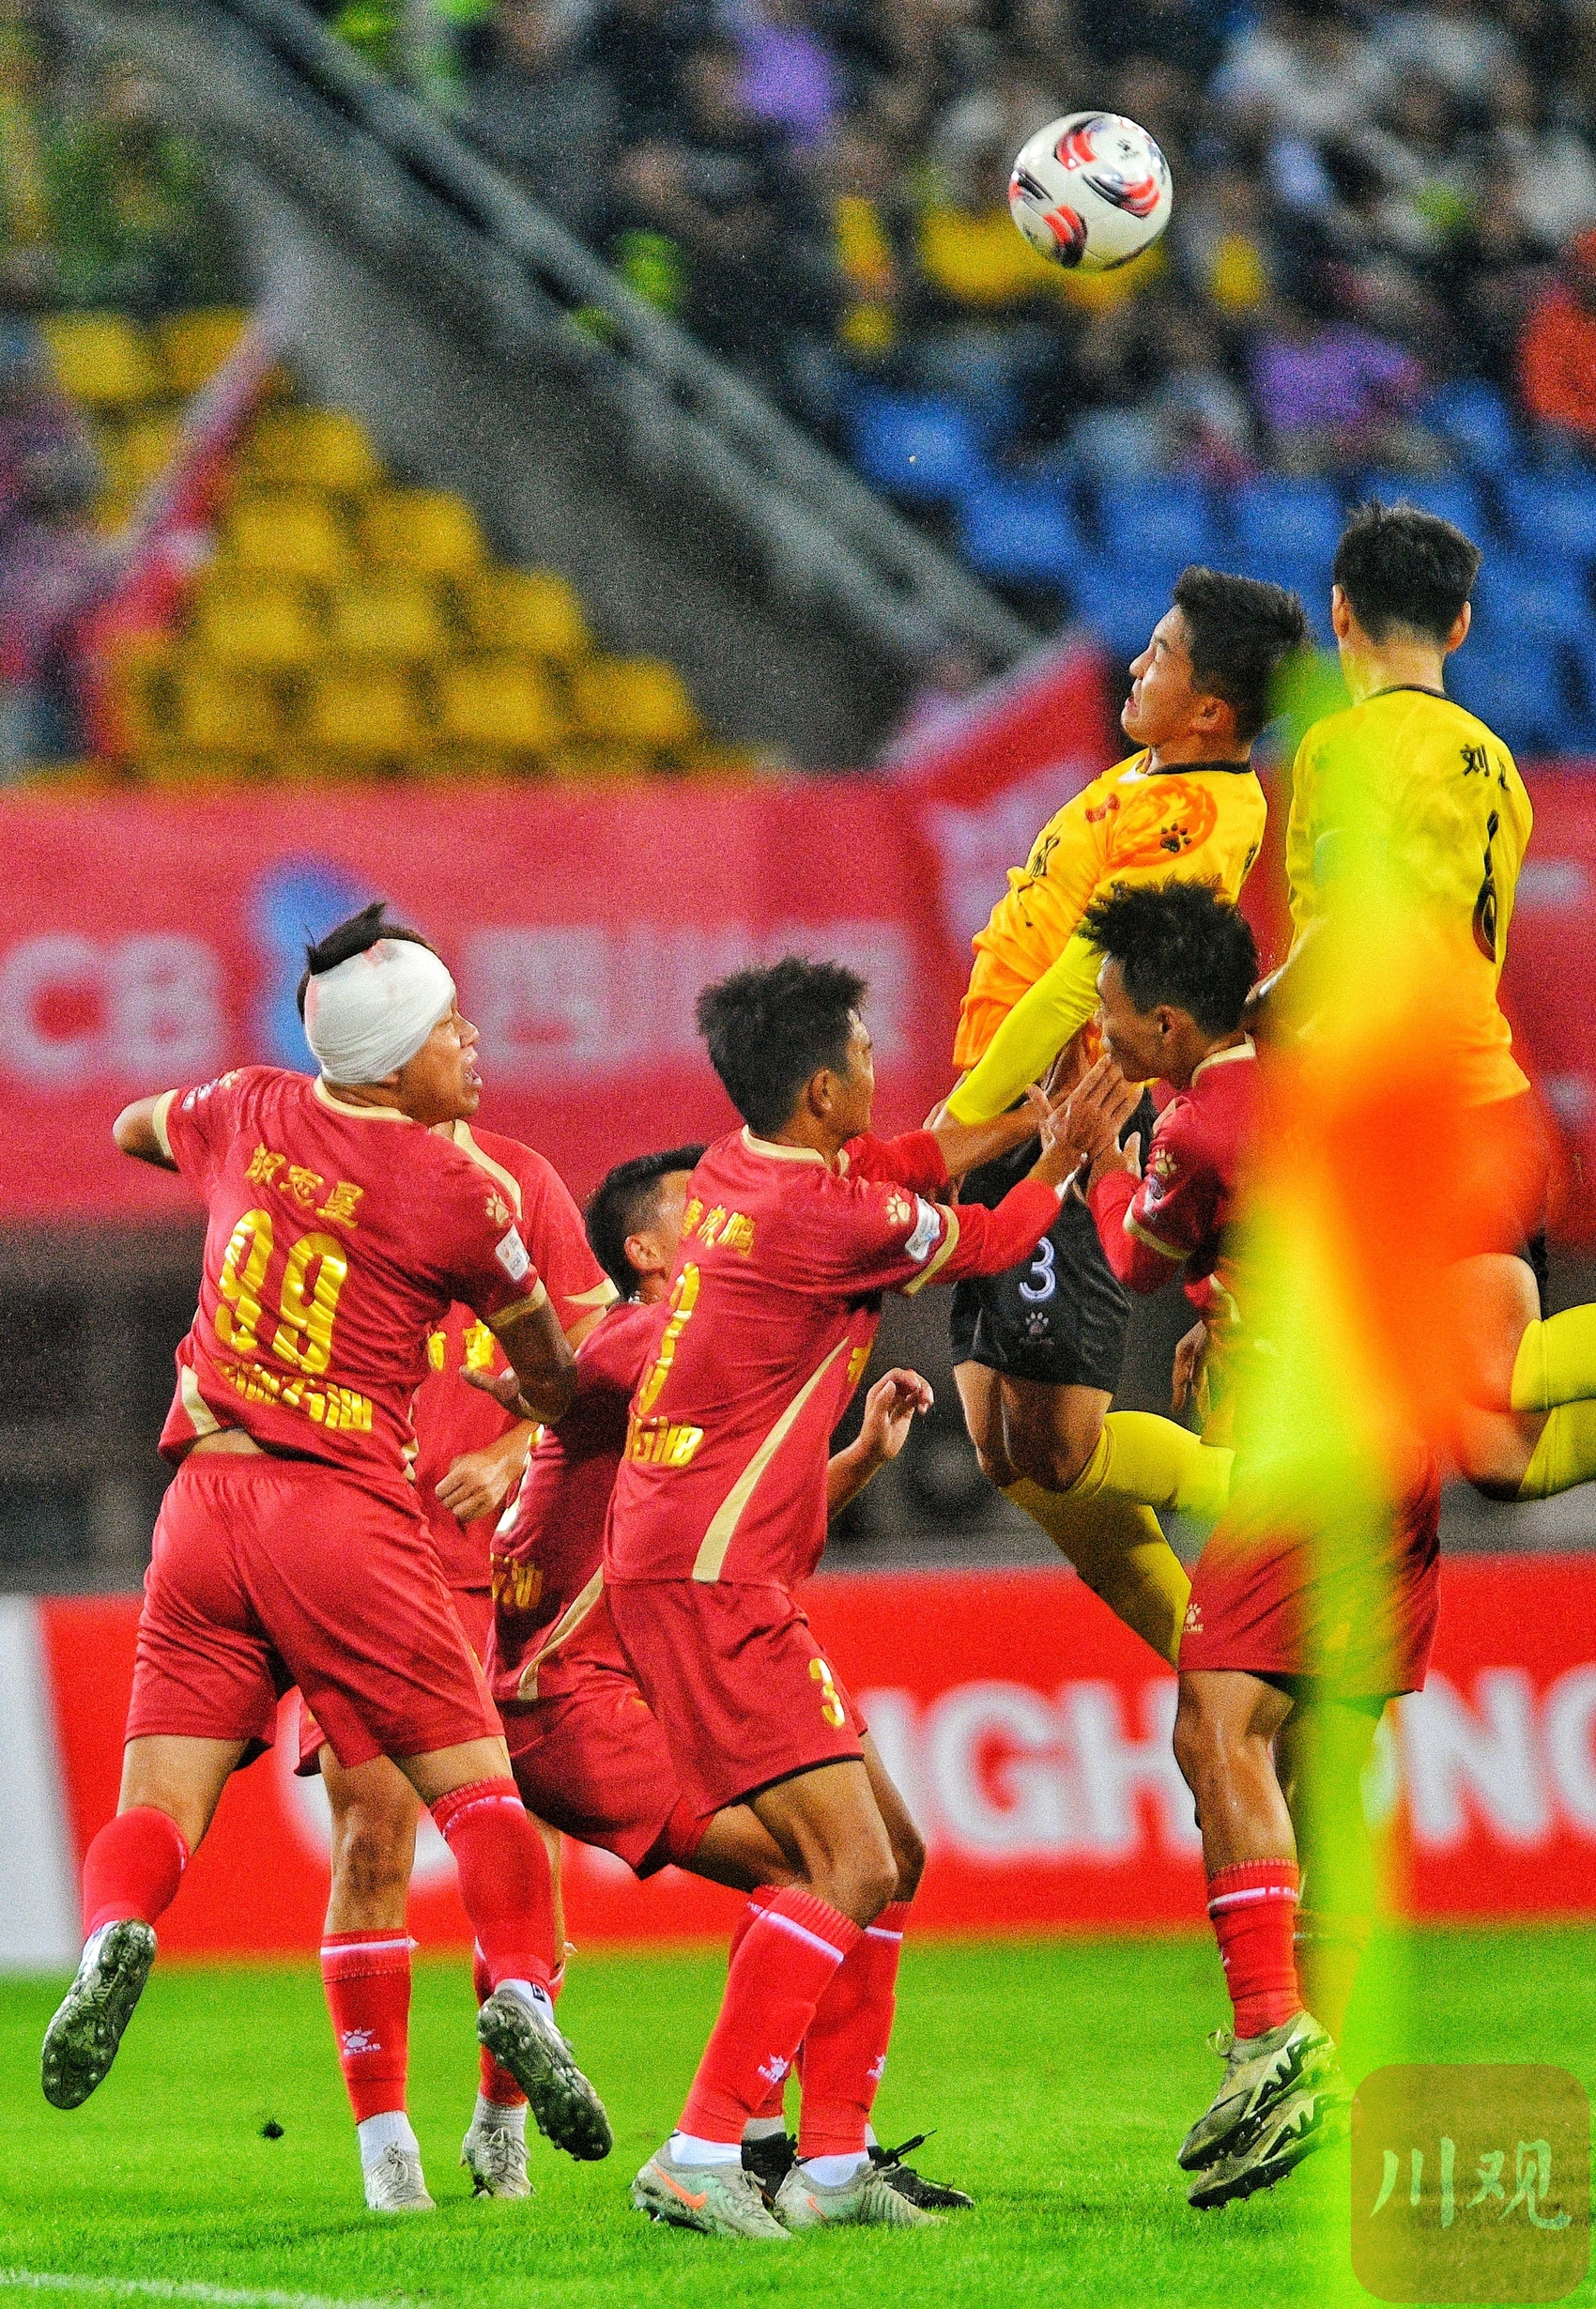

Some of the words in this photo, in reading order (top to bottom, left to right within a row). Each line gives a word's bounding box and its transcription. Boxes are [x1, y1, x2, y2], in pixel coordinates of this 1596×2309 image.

[215, 1208, 348, 1375] 99
[1019, 1236, 1056, 1301] 3
[809, 1657, 846, 1726] 3
